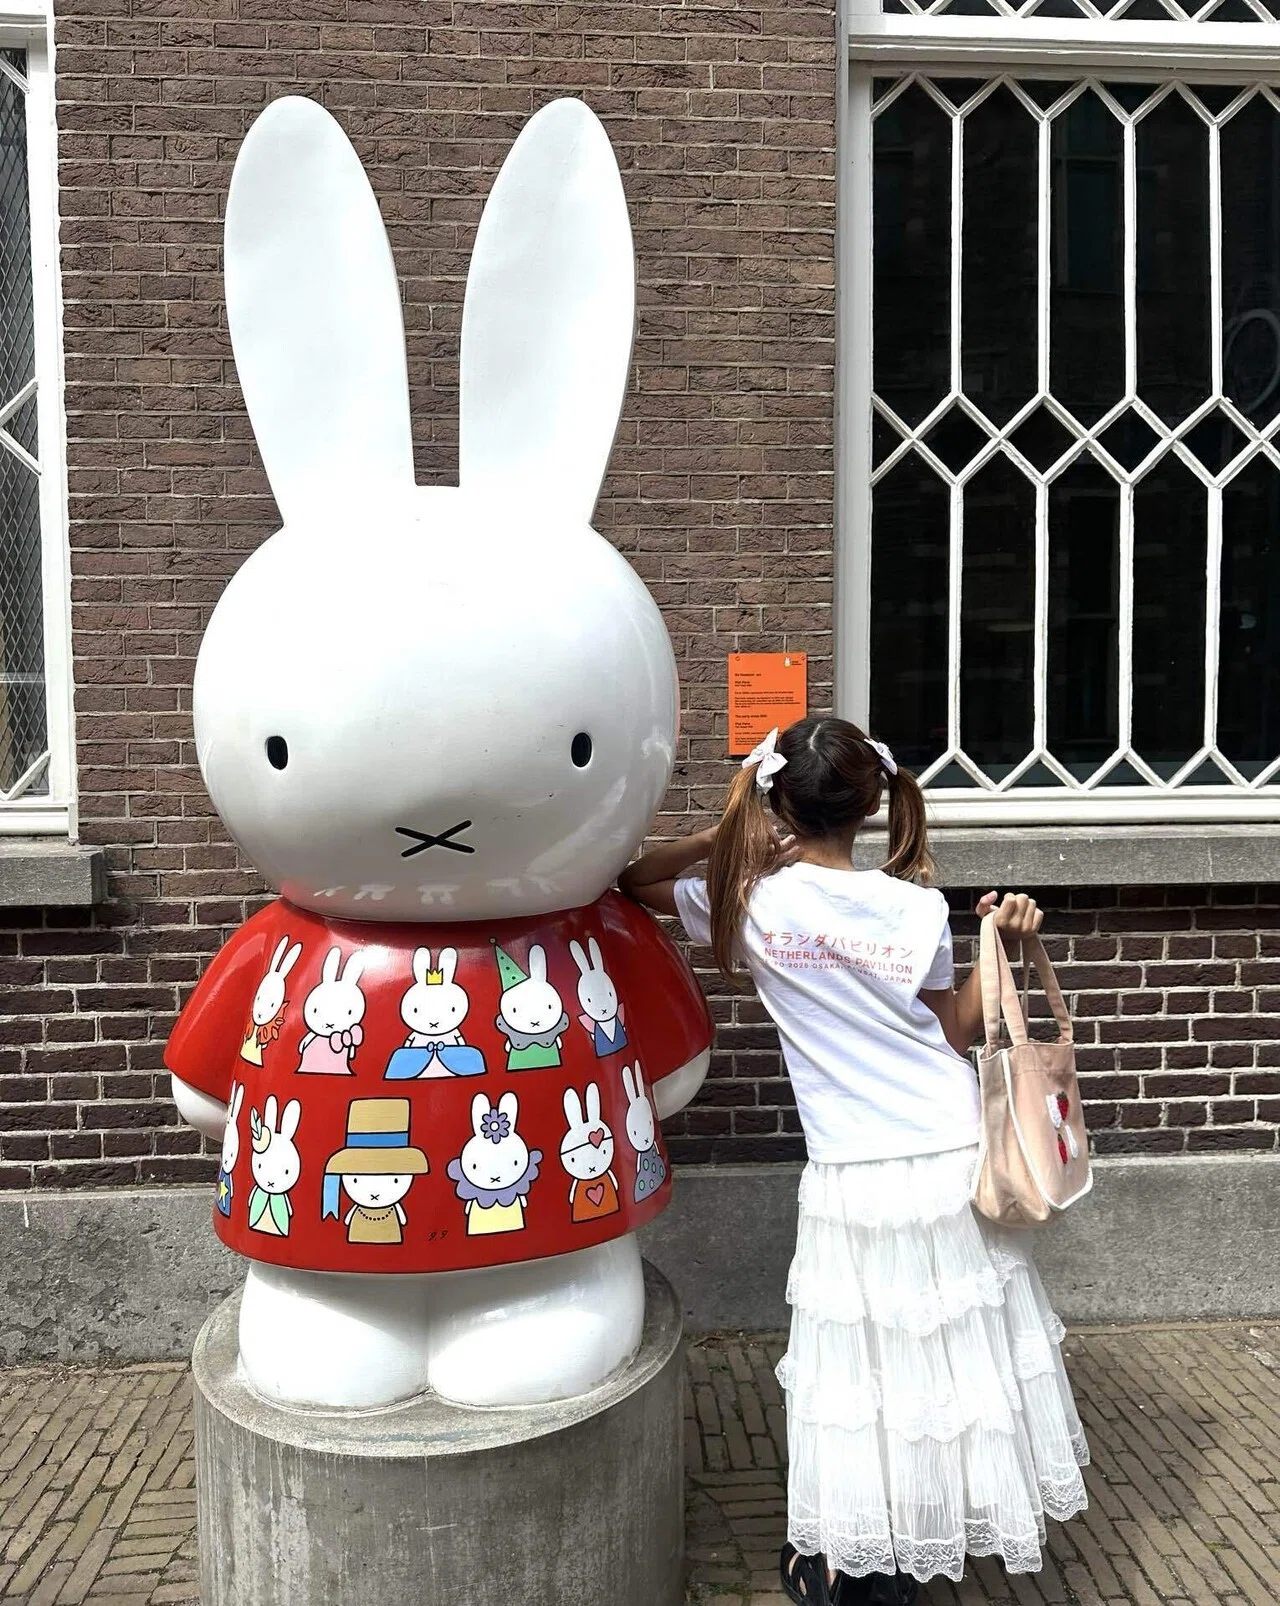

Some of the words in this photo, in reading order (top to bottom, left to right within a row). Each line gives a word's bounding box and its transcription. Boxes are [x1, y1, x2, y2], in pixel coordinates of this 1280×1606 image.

[763, 930, 913, 959] オランダパビリオン
[763, 959, 785, 968] EPO
[884, 974, 913, 985] JAPAN
[764, 947, 851, 964] NETHERLANDS
[855, 957, 913, 974] PAVILION
